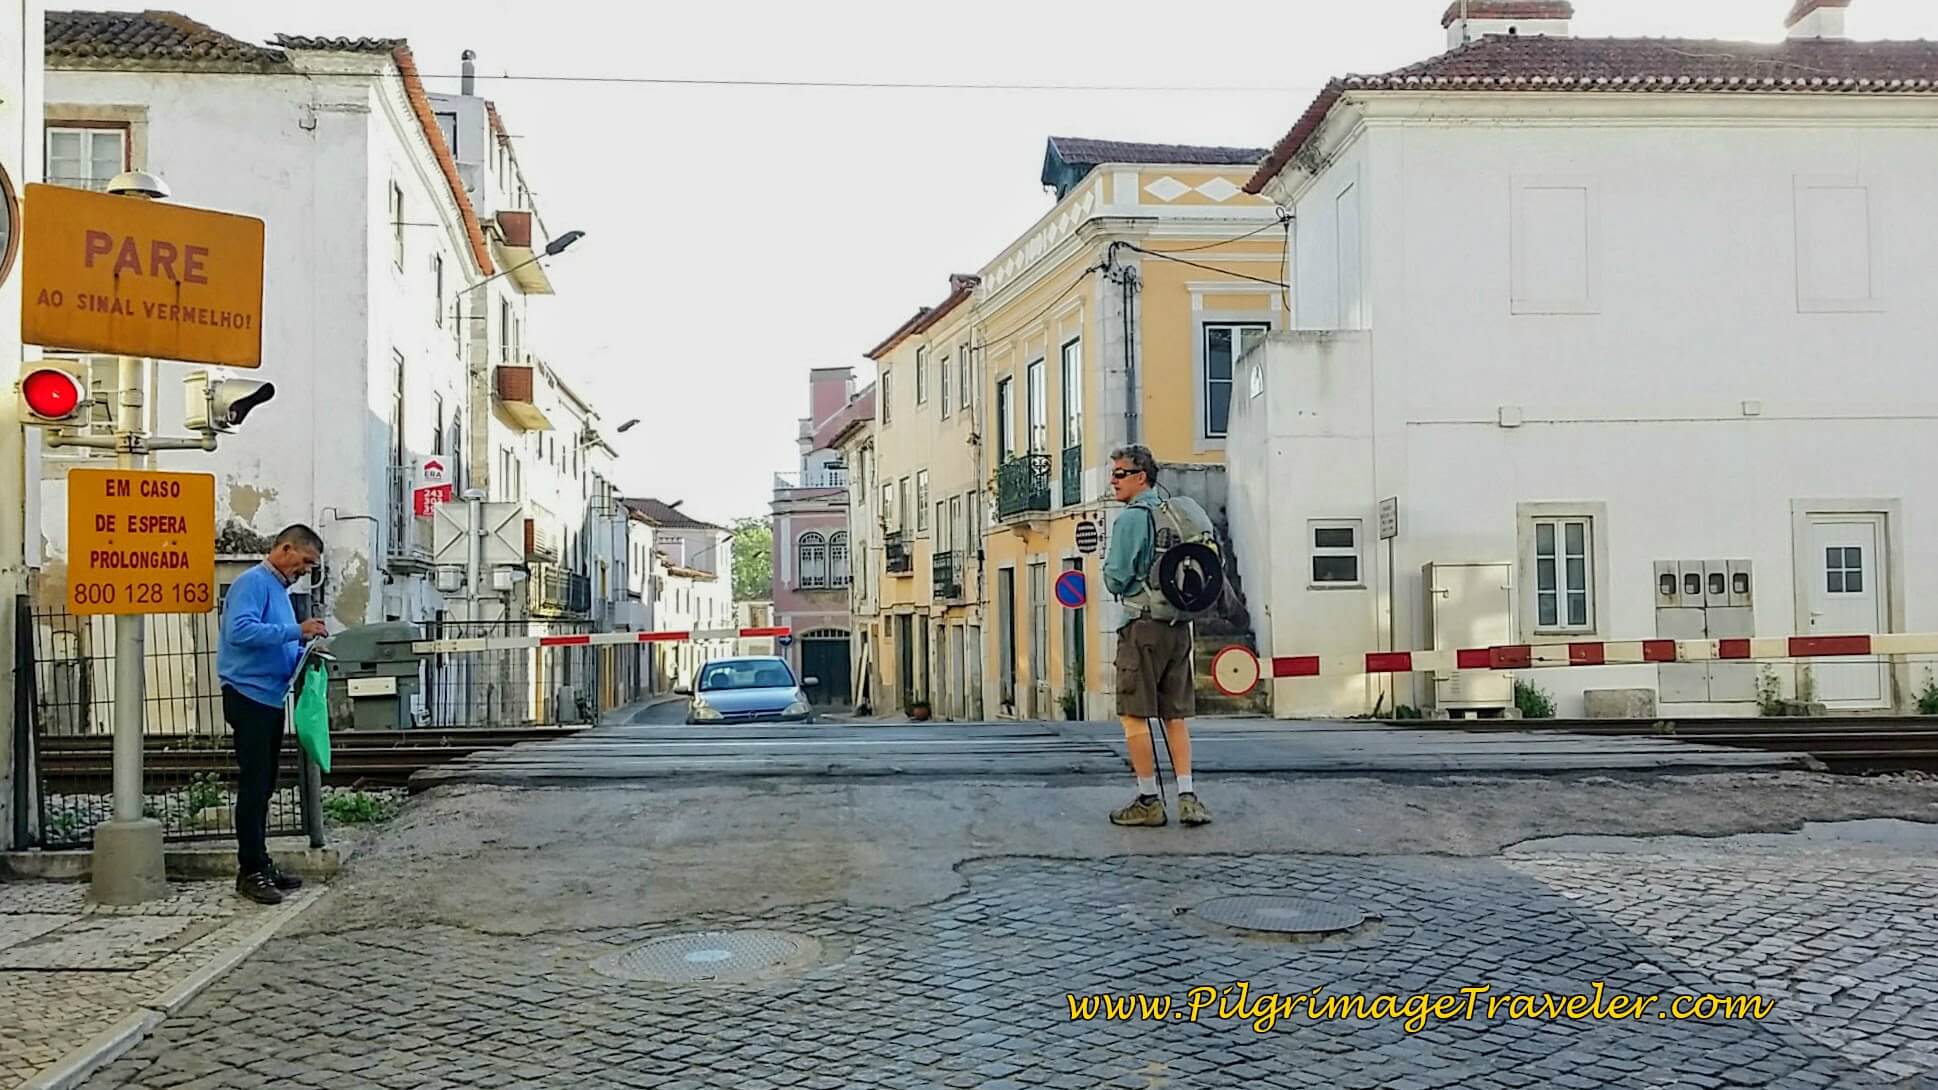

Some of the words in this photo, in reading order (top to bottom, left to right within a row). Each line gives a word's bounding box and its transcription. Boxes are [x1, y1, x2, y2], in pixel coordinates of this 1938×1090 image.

[84, 229, 209, 285] PARE
[37, 287, 64, 308] AO
[77, 293, 135, 317] SINAL
[143, 300, 252, 330] VERMELHO!
[105, 479, 131, 497] EM
[140, 480, 180, 498] CASO
[95, 514, 116, 532] DE
[128, 515, 187, 534] ESPERA
[90, 550, 190, 569] PROLONGADA
[74, 583, 116, 604] 800
[124, 583, 163, 603] 128
[172, 582, 209, 603] 163
